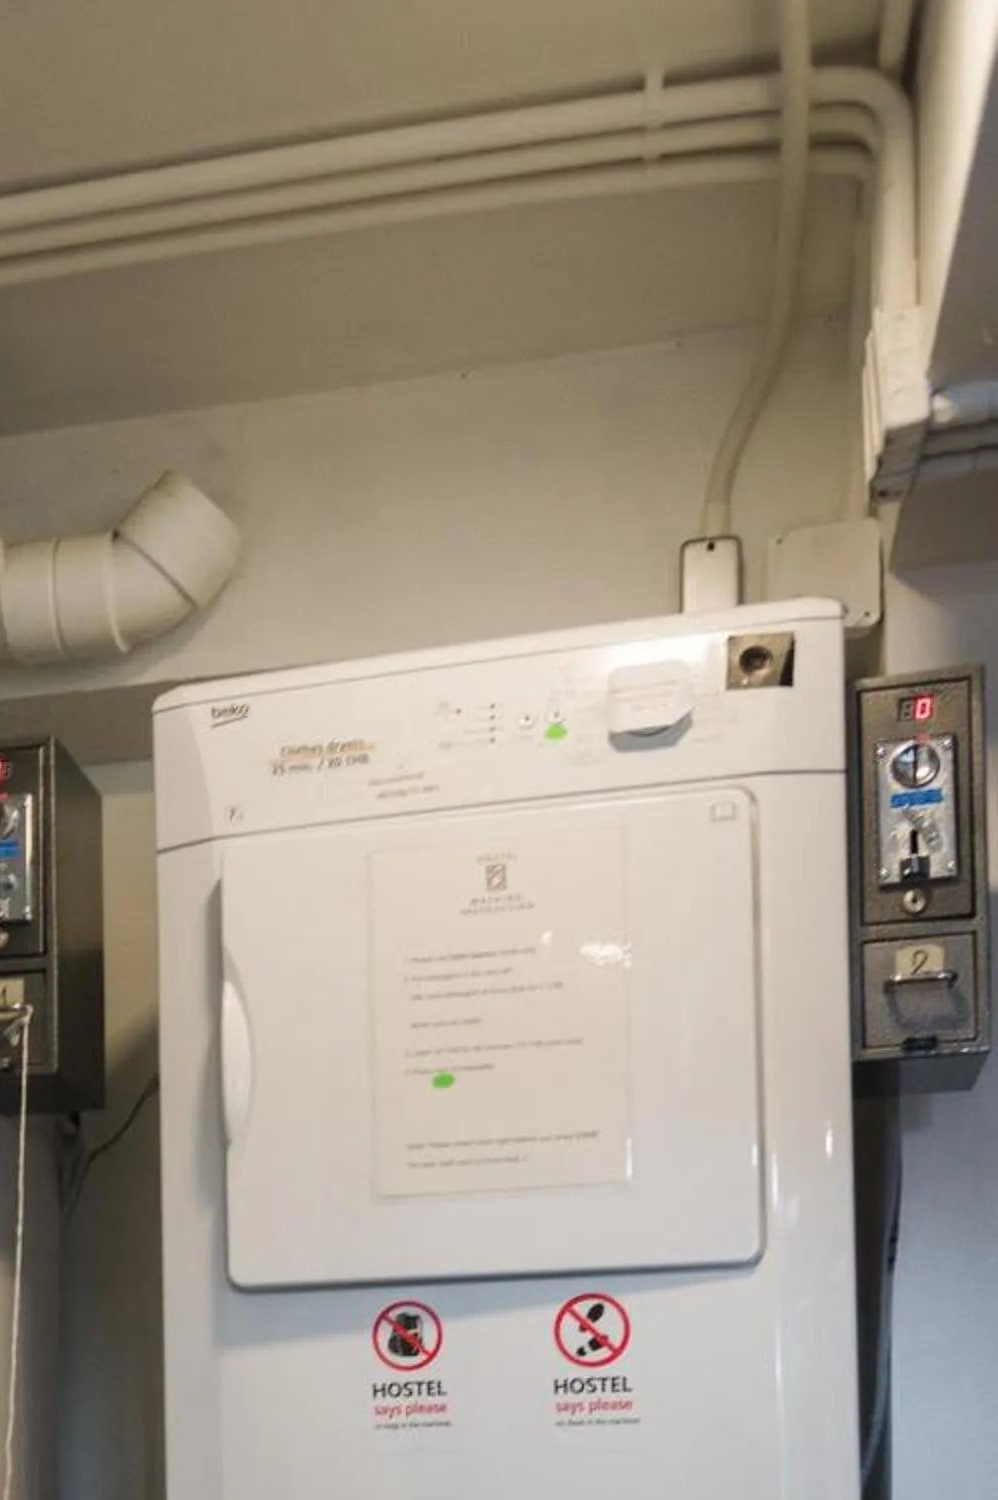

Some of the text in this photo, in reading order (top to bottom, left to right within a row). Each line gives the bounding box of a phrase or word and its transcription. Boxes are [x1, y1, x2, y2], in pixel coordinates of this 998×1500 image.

[210, 704, 250, 720] beko
[371, 1379, 448, 1399] HOSTEL
[553, 1376, 633, 1396] HOSTEL
[374, 1401, 448, 1419] says please
[555, 1398, 633, 1417] says please
